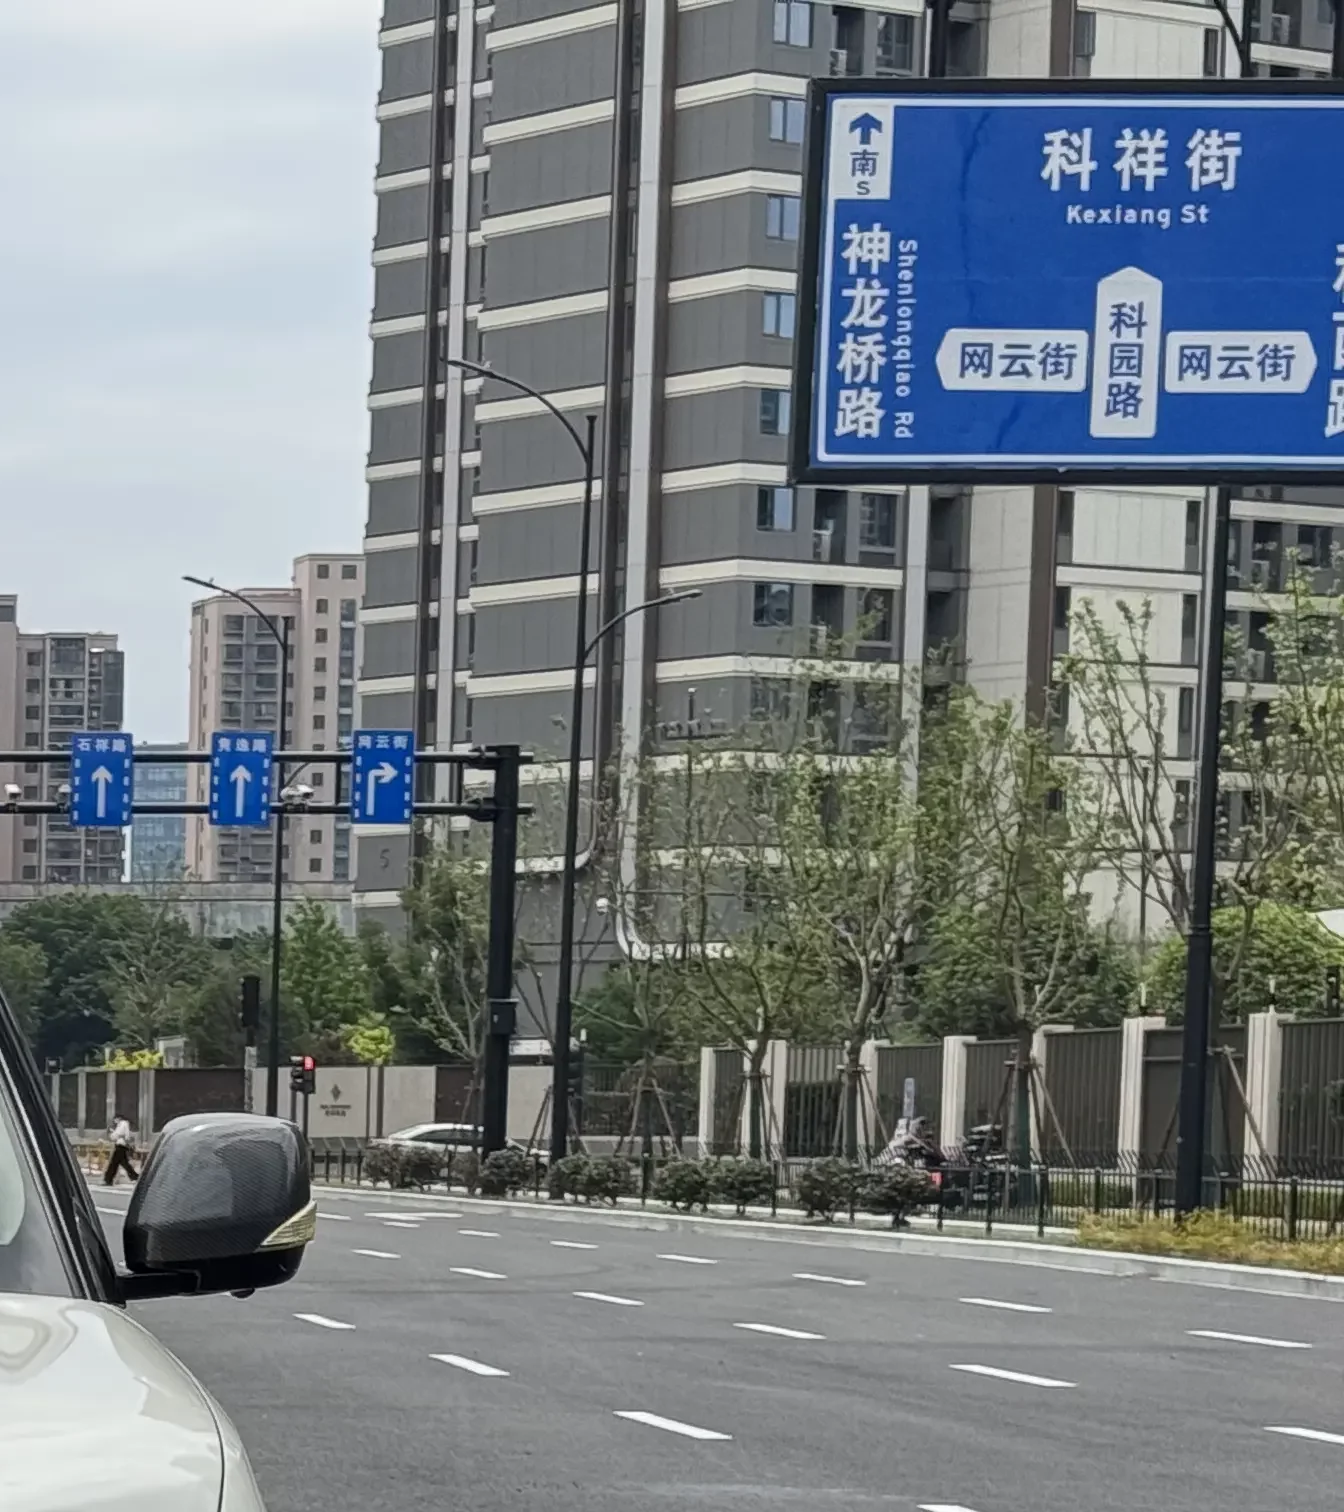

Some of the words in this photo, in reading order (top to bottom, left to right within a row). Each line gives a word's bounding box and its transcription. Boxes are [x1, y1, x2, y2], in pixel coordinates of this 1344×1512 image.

[849, 149, 878, 178] 南
[1041, 127, 1242, 192] 科祥街
[855, 181, 872, 196] S
[1066, 204, 1172, 231] Kexiang
[1180, 204, 1210, 225] St
[834, 222, 891, 440] 神龙桥路
[892, 239, 918, 398] Shenlongqiao
[958, 341, 1078, 381] 网云街
[1104, 302, 1147, 420] 科园路
[1177, 344, 1296, 382] 网云街
[893, 411, 914, 439] Rd
[379, 848, 391, 868] 5
